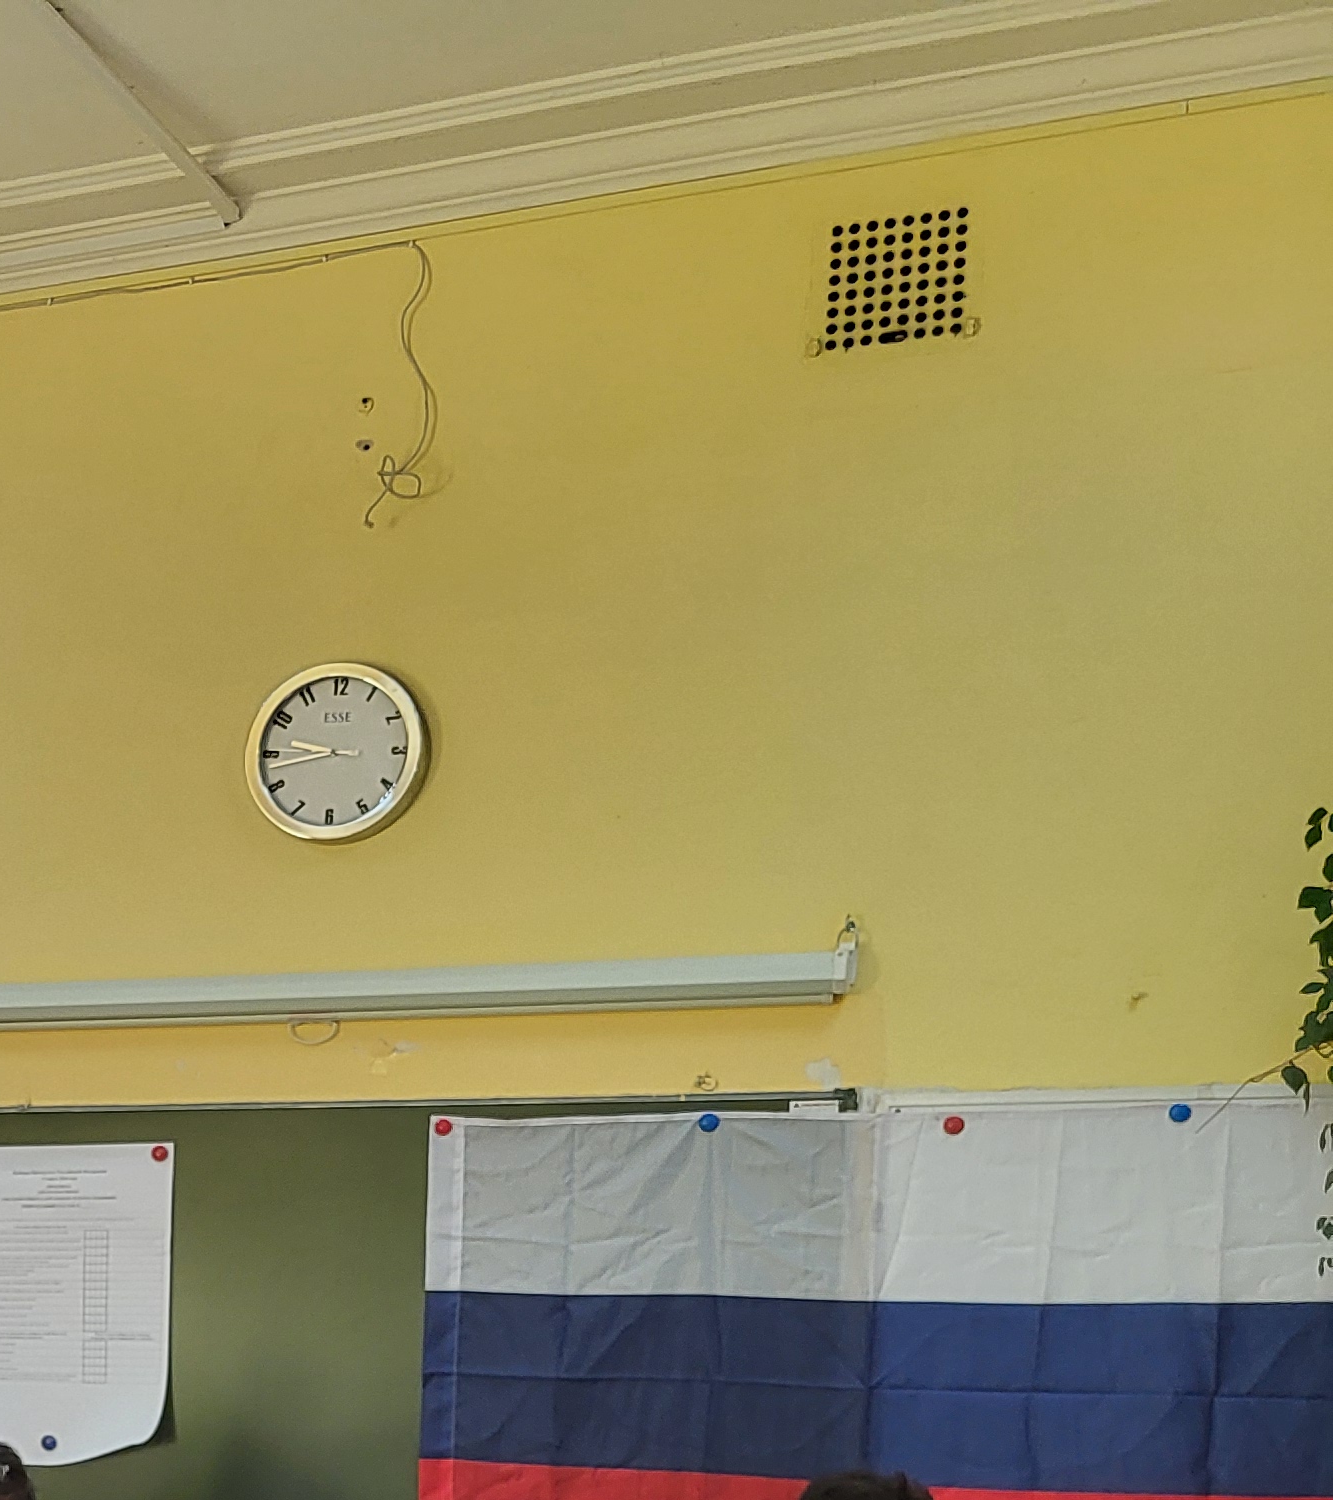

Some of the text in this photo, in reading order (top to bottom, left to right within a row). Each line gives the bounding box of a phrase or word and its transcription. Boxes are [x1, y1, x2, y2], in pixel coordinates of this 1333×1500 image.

[333, 677, 350, 697] 12
[366, 687, 379, 703] 1
[299, 687, 316, 707] 11
[273, 711, 294, 730] 10
[324, 712, 352, 724] ESSE
[385, 710, 402, 726] 2
[263, 750, 280, 759] 9
[391, 746, 407, 756] 3
[268, 779, 286, 794] 8
[380, 777, 394, 792] 4
[290, 800, 306, 817] 7
[356, 798, 370, 815] 5
[325, 809, 334, 826] 6
